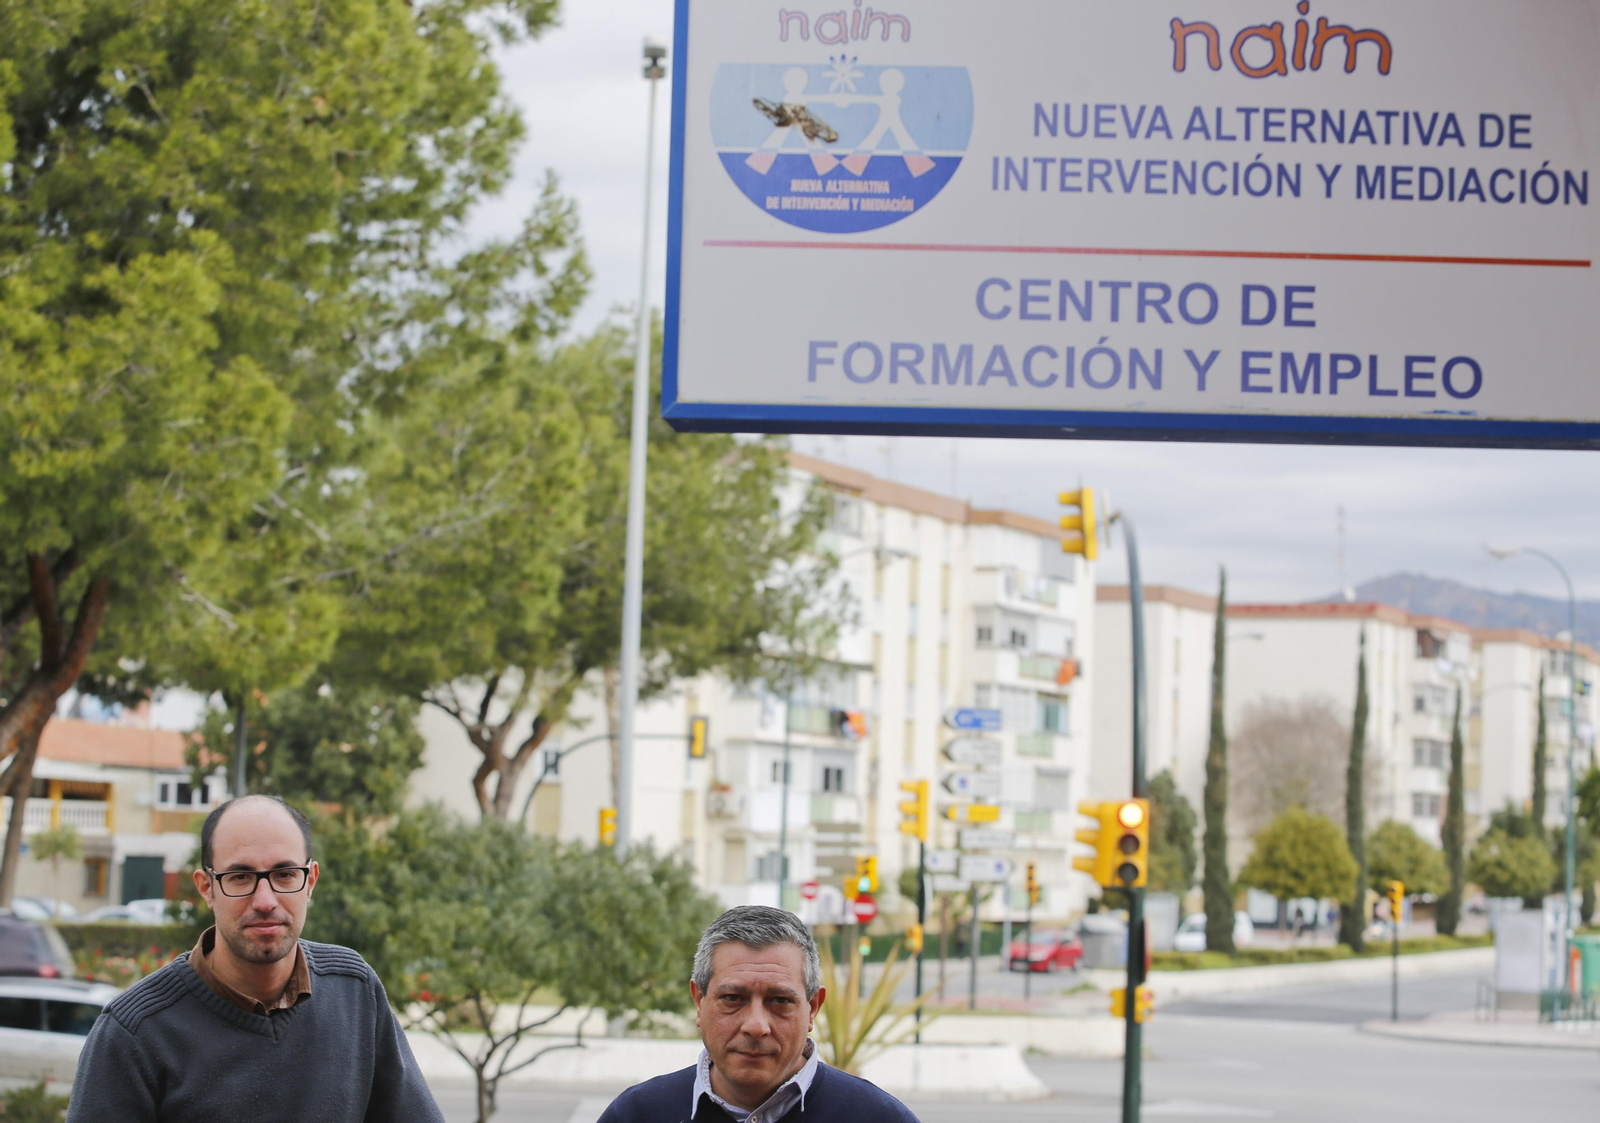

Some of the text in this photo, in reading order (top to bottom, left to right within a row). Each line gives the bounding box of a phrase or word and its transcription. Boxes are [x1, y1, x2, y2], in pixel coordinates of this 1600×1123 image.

[779, 0, 911, 45] naim
[1170, 1, 1392, 78] naim
[1033, 103, 1532, 149] NUEVA ALTERNATIVA DE
[825, 180, 890, 194] ALTERNATIVA
[991, 154, 1589, 205] INTERVENCIÓN Y MEDIACIÓN
[851, 197, 860, 211] Y
[975, 277, 1317, 328] CENTRO DE
[809, 336, 1483, 400] FORMACIÓN Y EMPLEO
